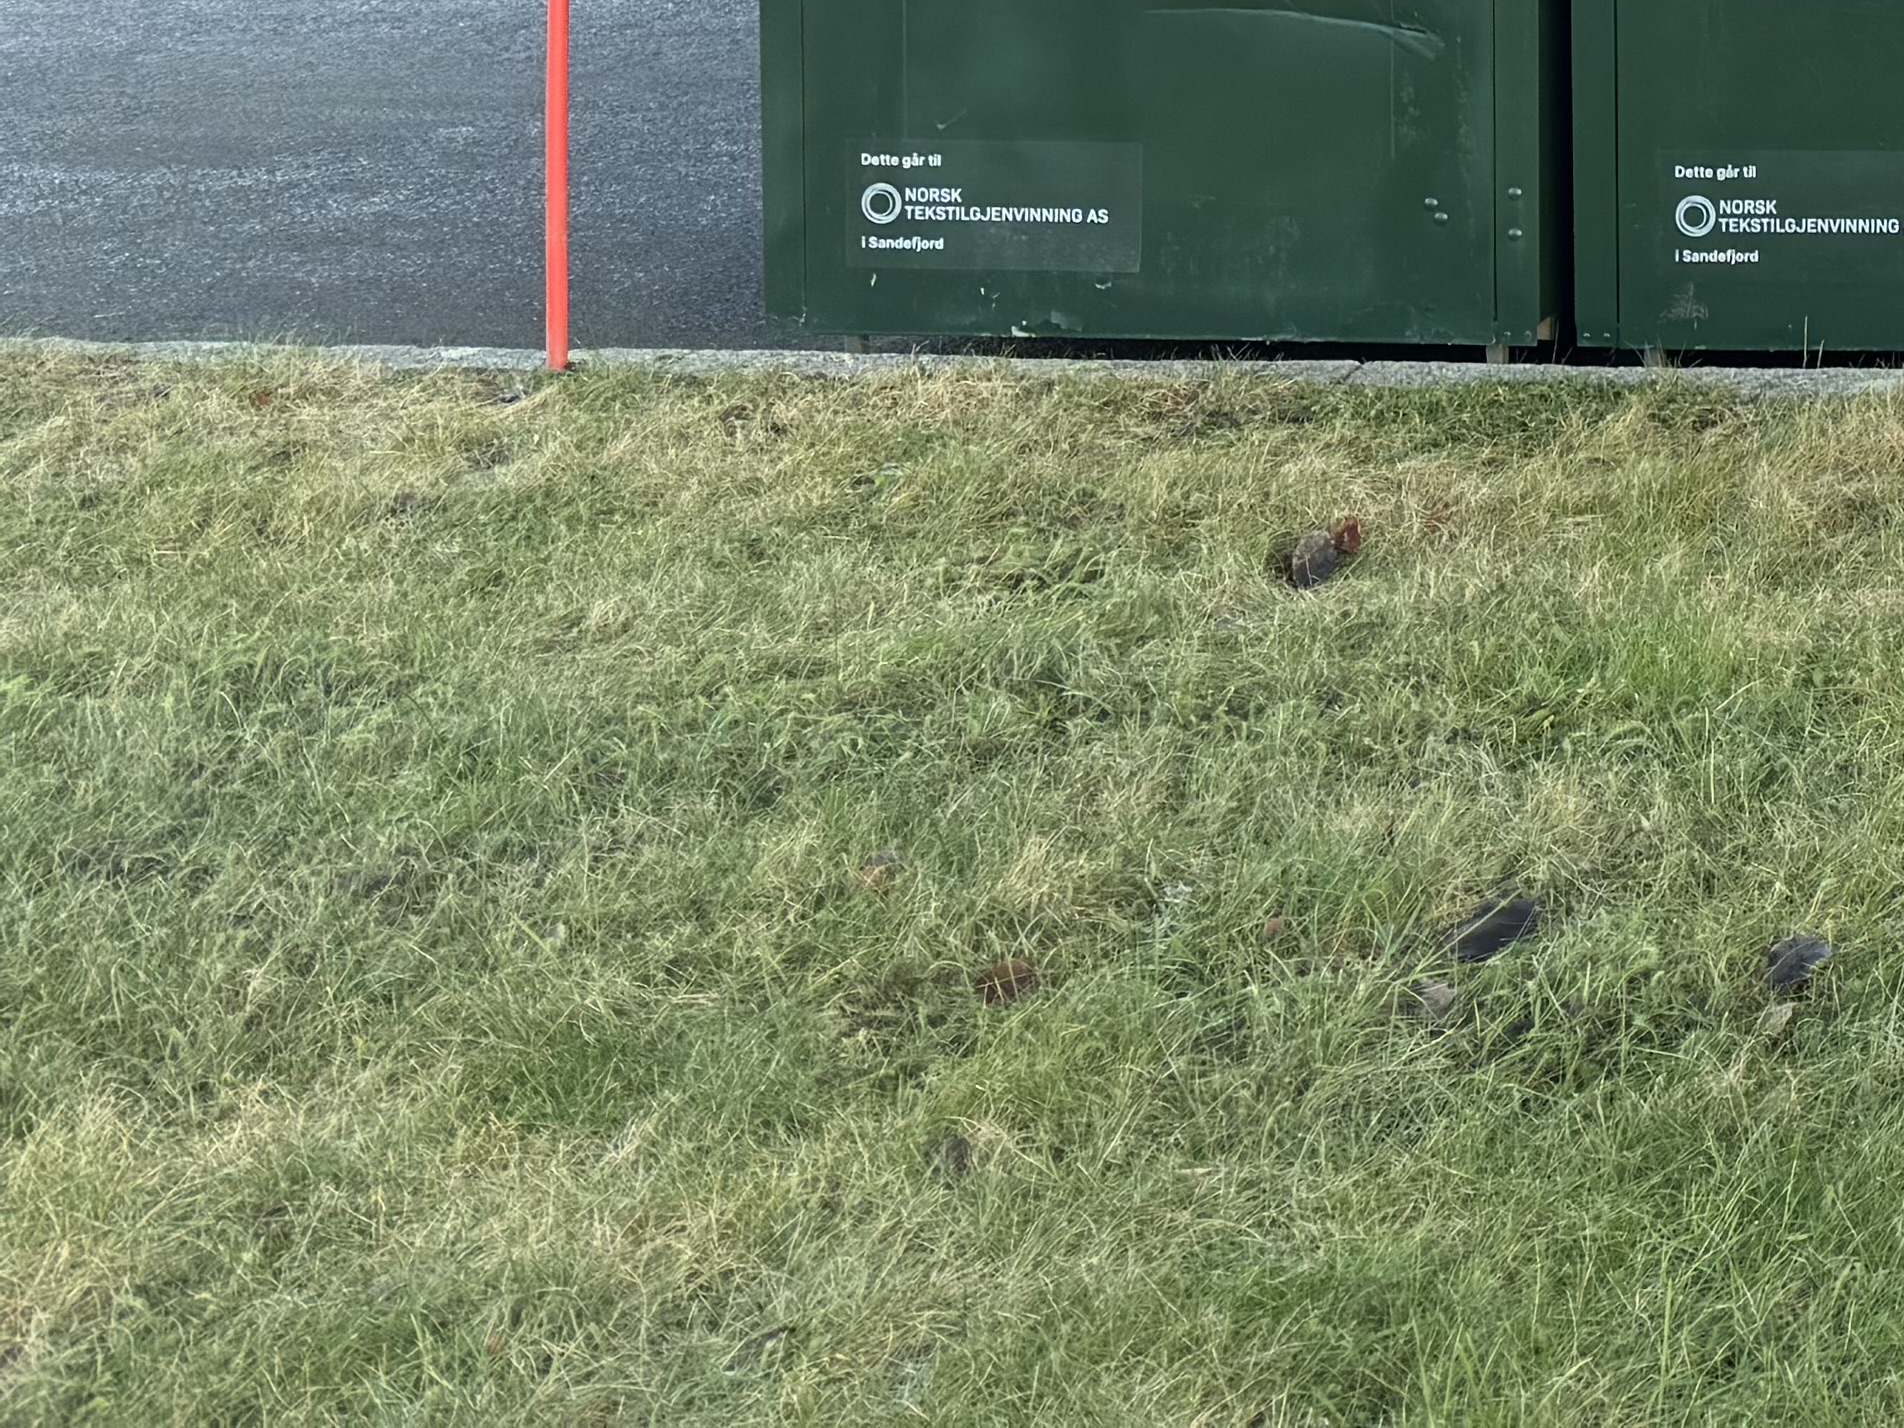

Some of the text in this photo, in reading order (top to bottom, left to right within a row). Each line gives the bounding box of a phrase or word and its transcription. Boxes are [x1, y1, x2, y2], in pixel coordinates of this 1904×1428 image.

[861, 153, 941, 168] Dette går til
[1675, 165, 1756, 180] Dette går til
[905, 187, 962, 203] NORSK
[1720, 199, 1777, 215] NORSK
[904, 206, 1109, 224] TEKSTILGJENVINNING AS
[1718, 218, 1900, 233] TEKSTILGJENVINNING
[861, 236, 944, 251] i Sandefjord
[1675, 249, 1758, 264] i Sandefjord
